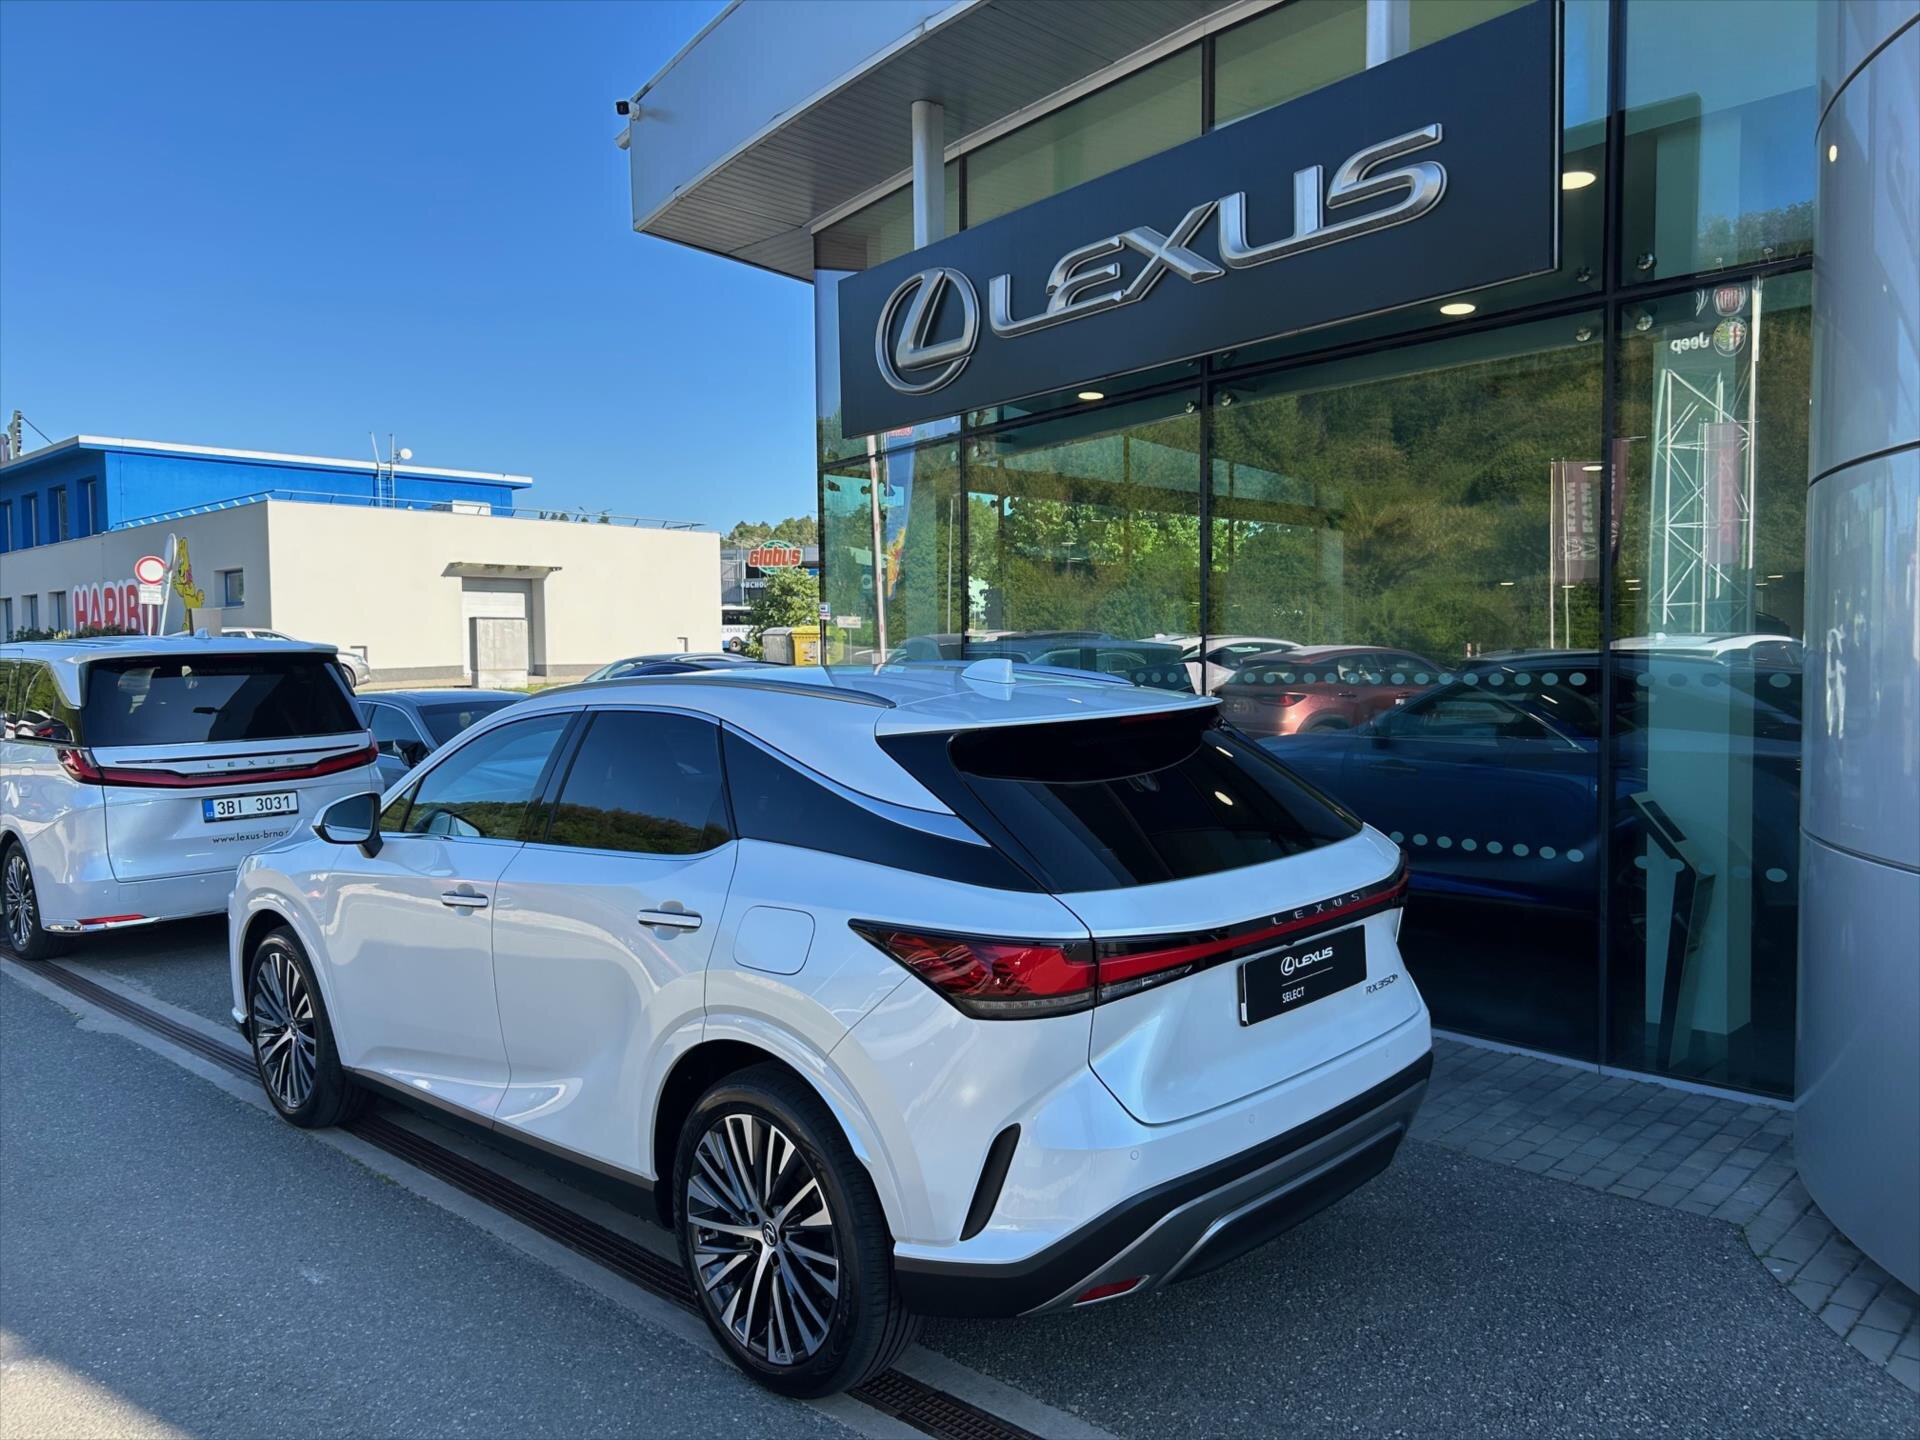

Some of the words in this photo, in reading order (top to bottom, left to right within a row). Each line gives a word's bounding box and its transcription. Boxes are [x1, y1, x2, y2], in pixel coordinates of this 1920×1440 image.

[988, 122, 1447, 338] LEXUS
[207, 757, 295, 769] LEXUS
[217, 800, 242, 815] 3BI
[255, 795, 290, 811] 3031
[1272, 892, 1360, 925] LEXUS
[1295, 946, 1333, 968] LEXUS
[1282, 986, 1305, 1003] SELECT
